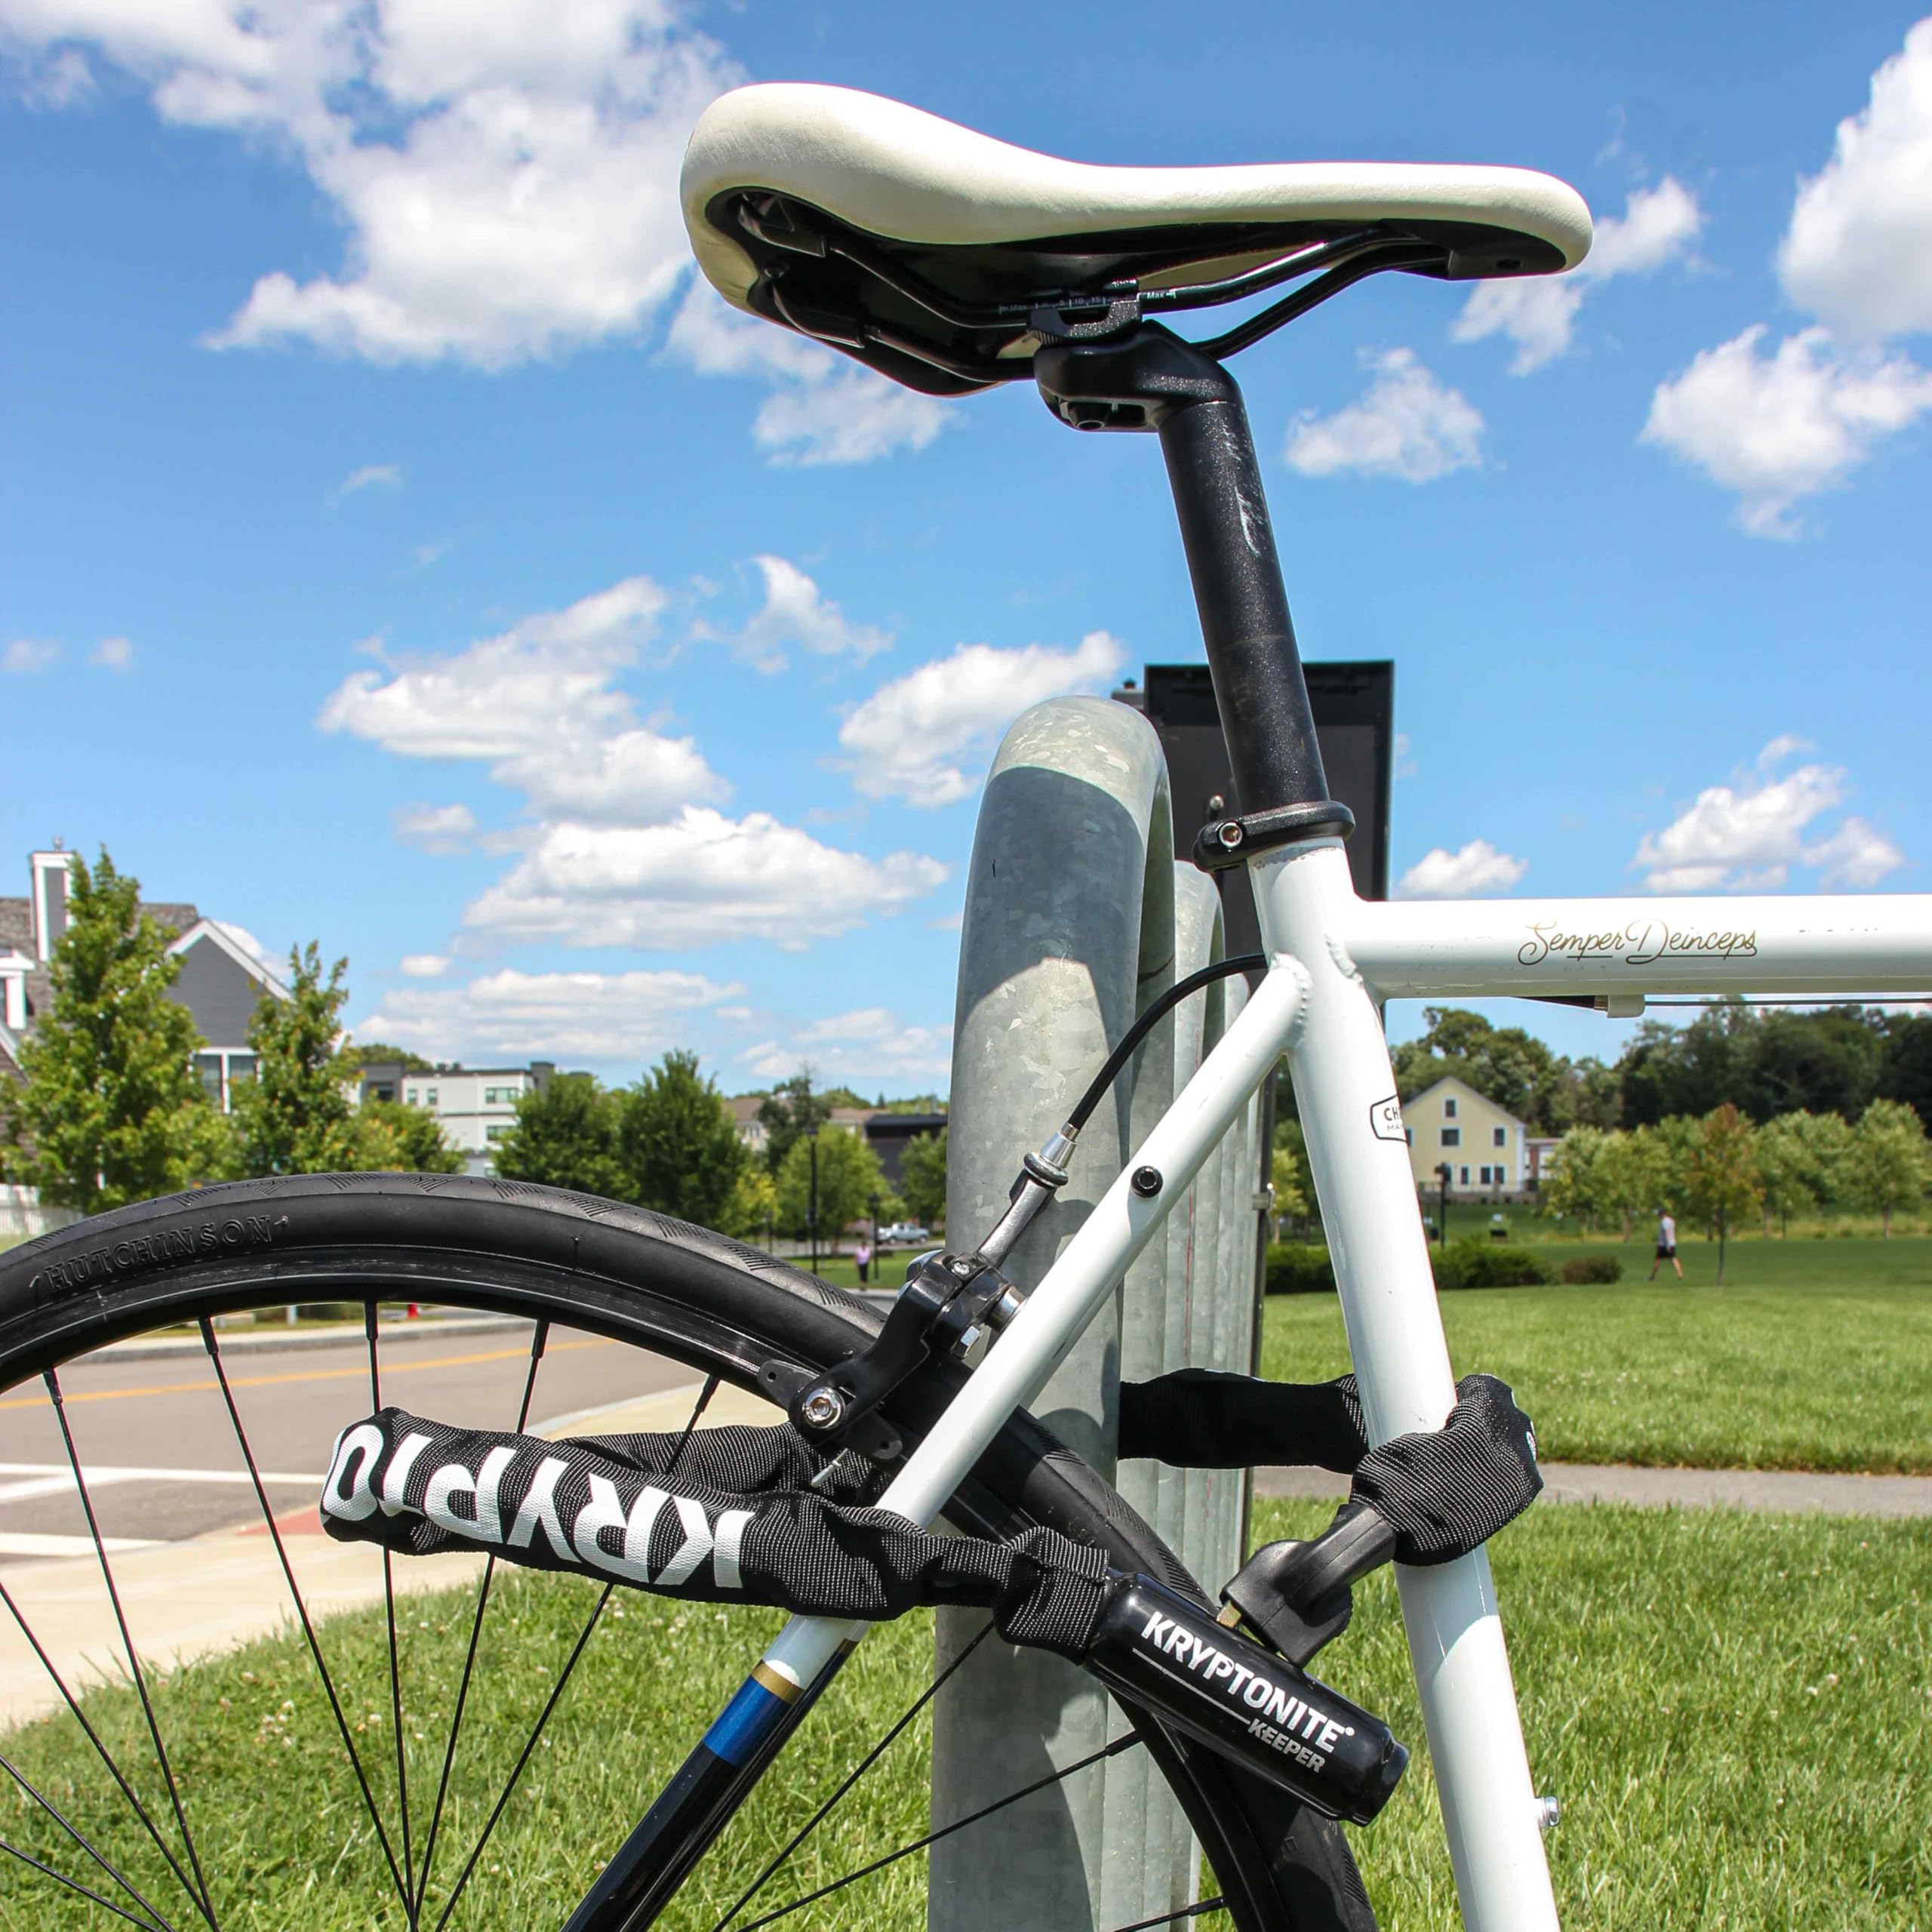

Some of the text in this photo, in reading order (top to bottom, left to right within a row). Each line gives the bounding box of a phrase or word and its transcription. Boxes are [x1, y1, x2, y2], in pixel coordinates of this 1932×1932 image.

[1146, 291, 1164, 300] Max
[1518, 918, 1758, 966] Semper Deinceps
[1383, 1106, 1401, 1121] CH
[1386, 1124, 1402, 1132] MA
[44, 1214, 272, 1293] HUTCHINSON
[1140, 1611, 1349, 1754] KRYPTONITE
[1247, 1718, 1326, 1774] KEEPER
